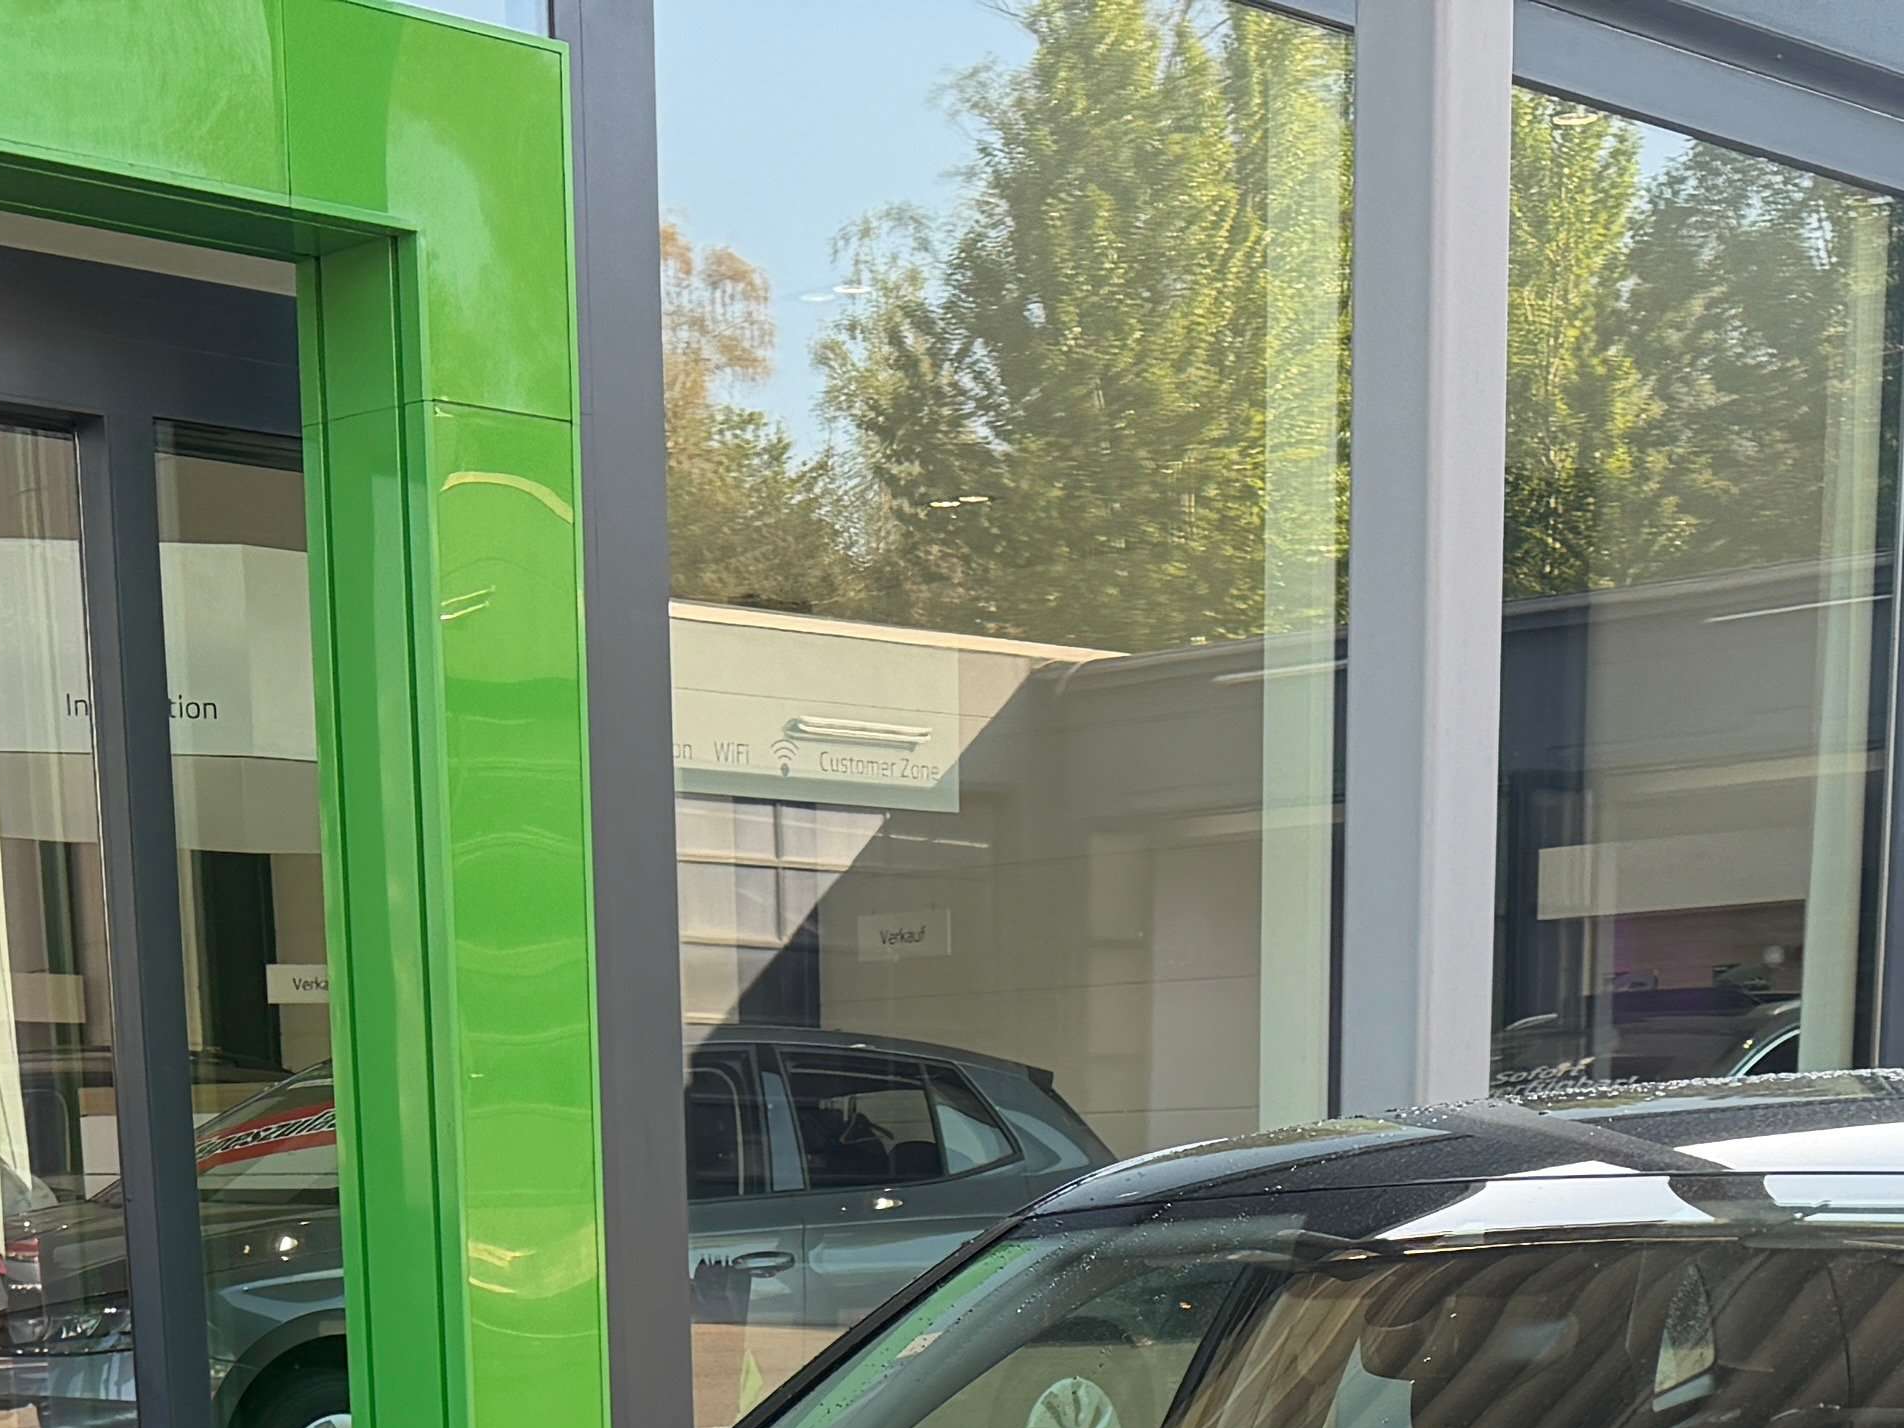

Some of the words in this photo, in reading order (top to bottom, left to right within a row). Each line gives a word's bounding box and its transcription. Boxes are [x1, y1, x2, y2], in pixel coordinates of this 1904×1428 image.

[66, 694, 218, 720] Intion
[819, 752, 896, 777] Customer
[292, 976, 329, 991] Verka
